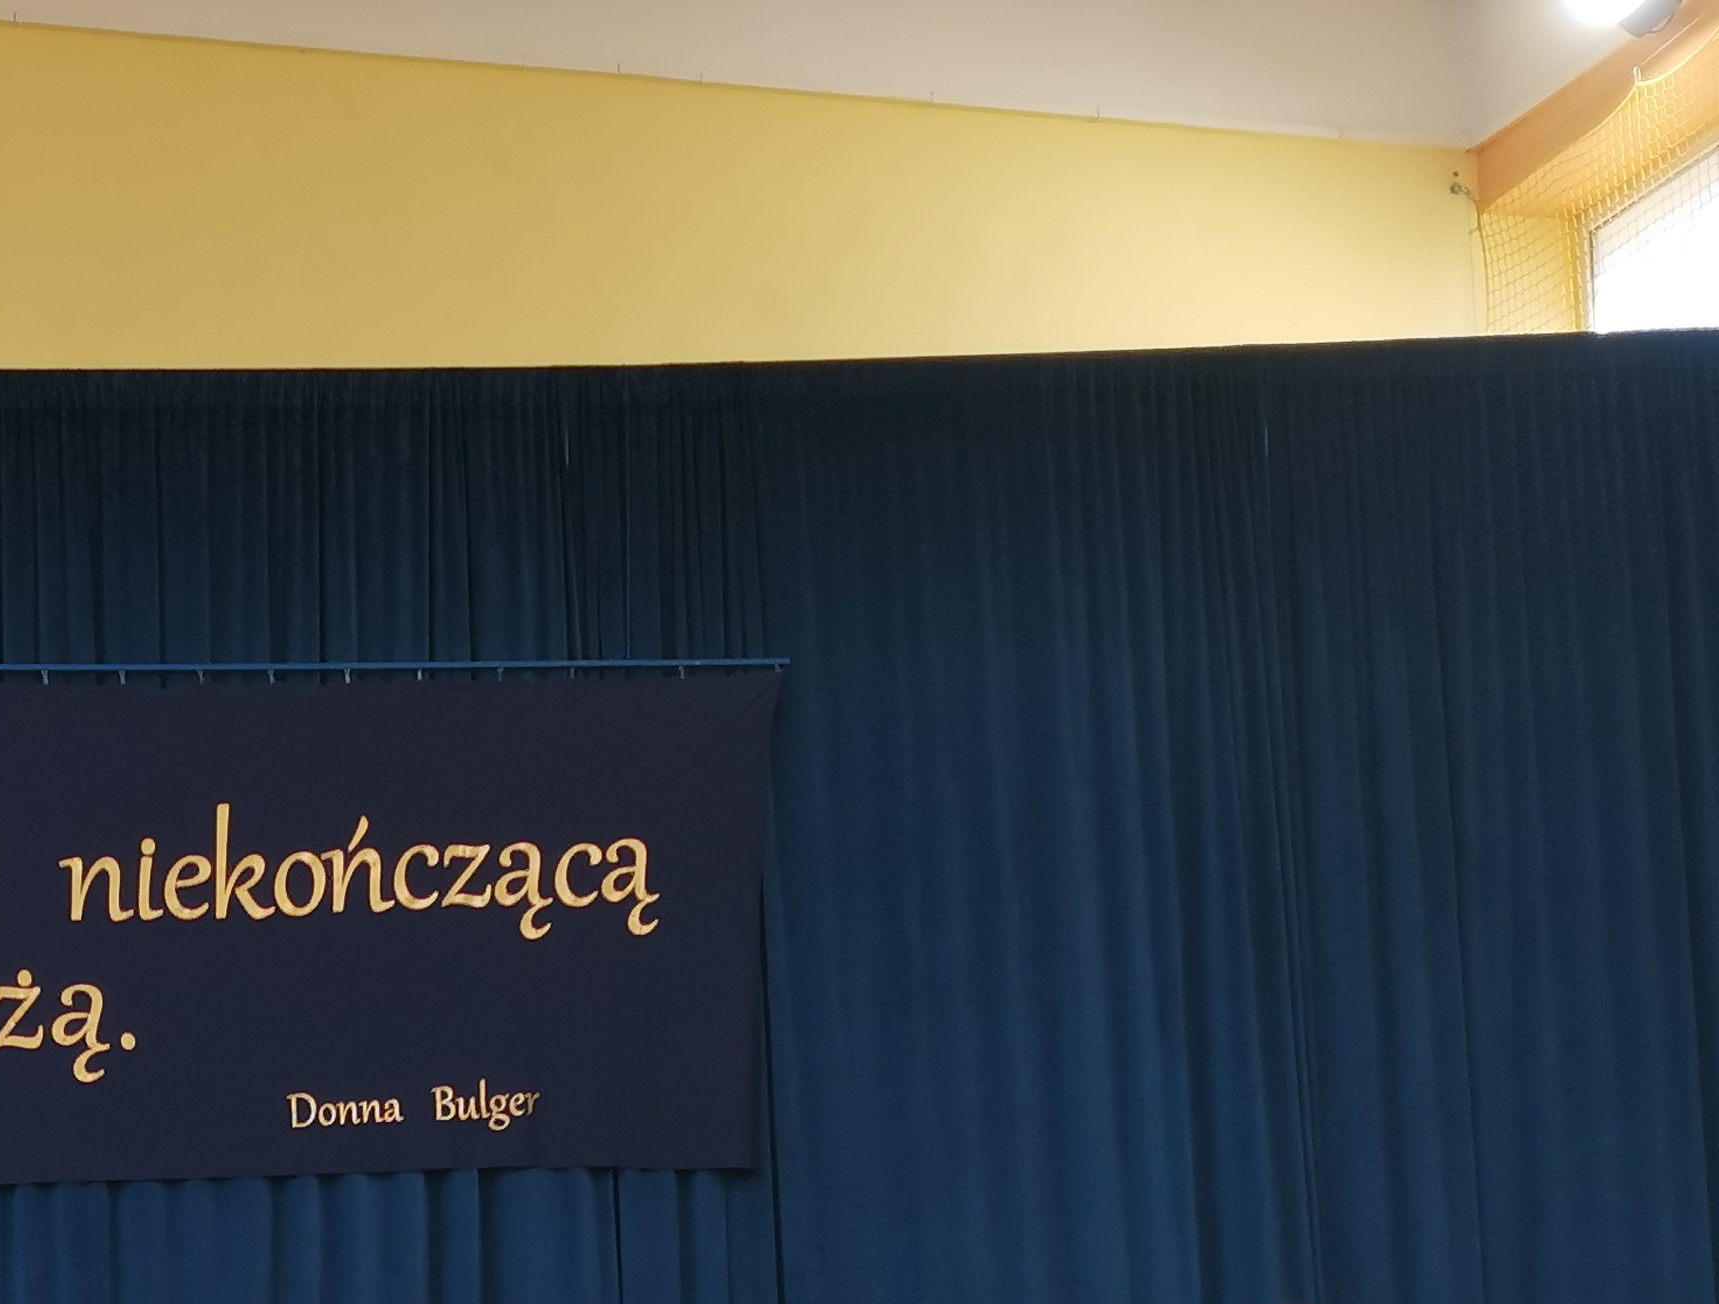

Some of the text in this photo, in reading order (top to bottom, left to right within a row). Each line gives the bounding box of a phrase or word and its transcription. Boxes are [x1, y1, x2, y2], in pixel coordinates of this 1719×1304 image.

[59, 802, 660, 940] niekończącą
[286, 1077, 541, 1132] Donna Bulger
